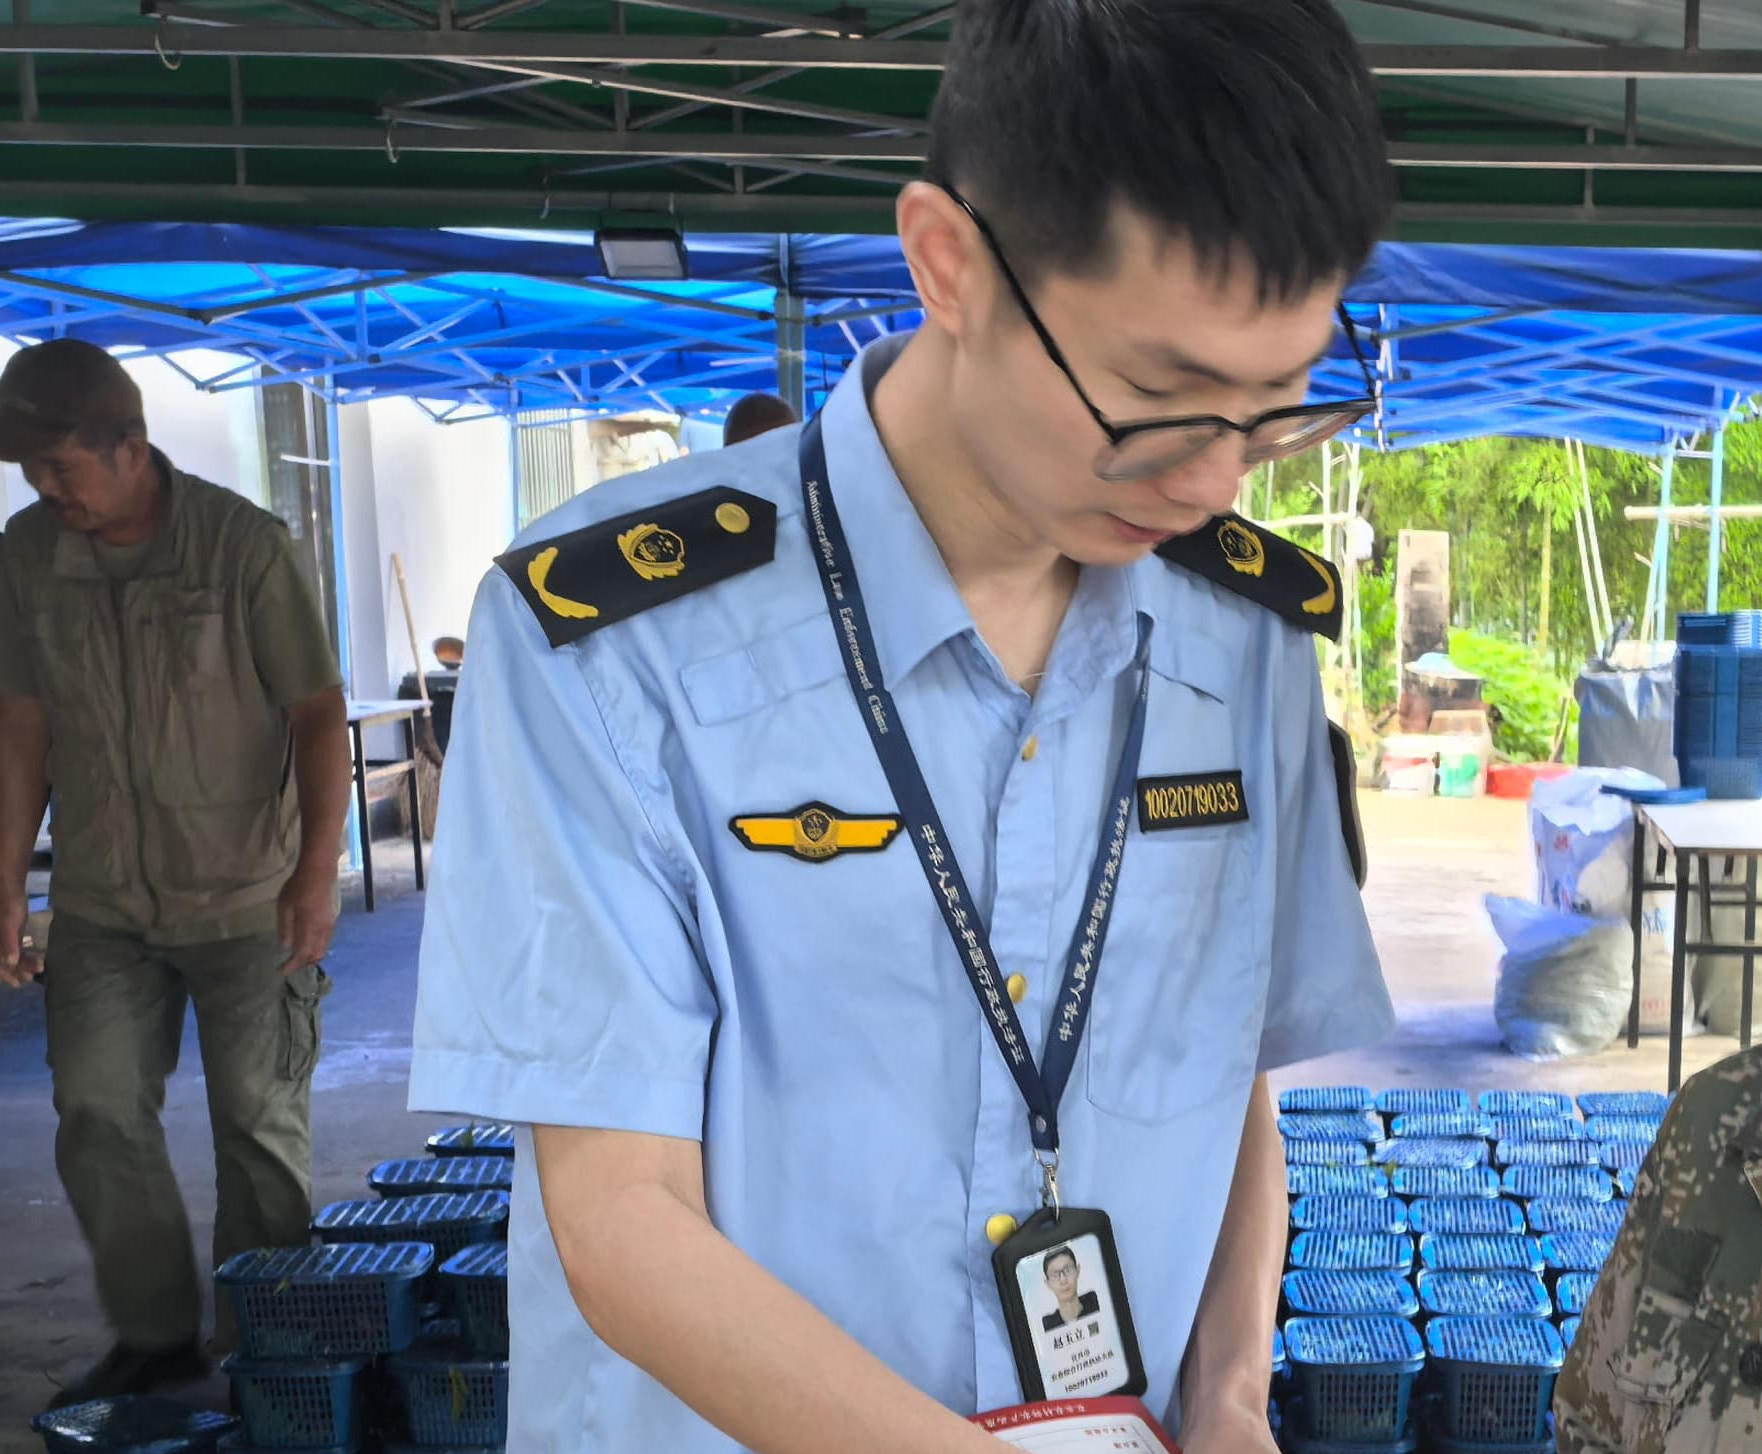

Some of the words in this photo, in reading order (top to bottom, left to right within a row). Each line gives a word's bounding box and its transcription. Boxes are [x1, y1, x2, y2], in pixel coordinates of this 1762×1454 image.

[1145, 782, 1240, 820] 10020719033
[921, 823, 1025, 1065] 中华人民共和国行政执法证
